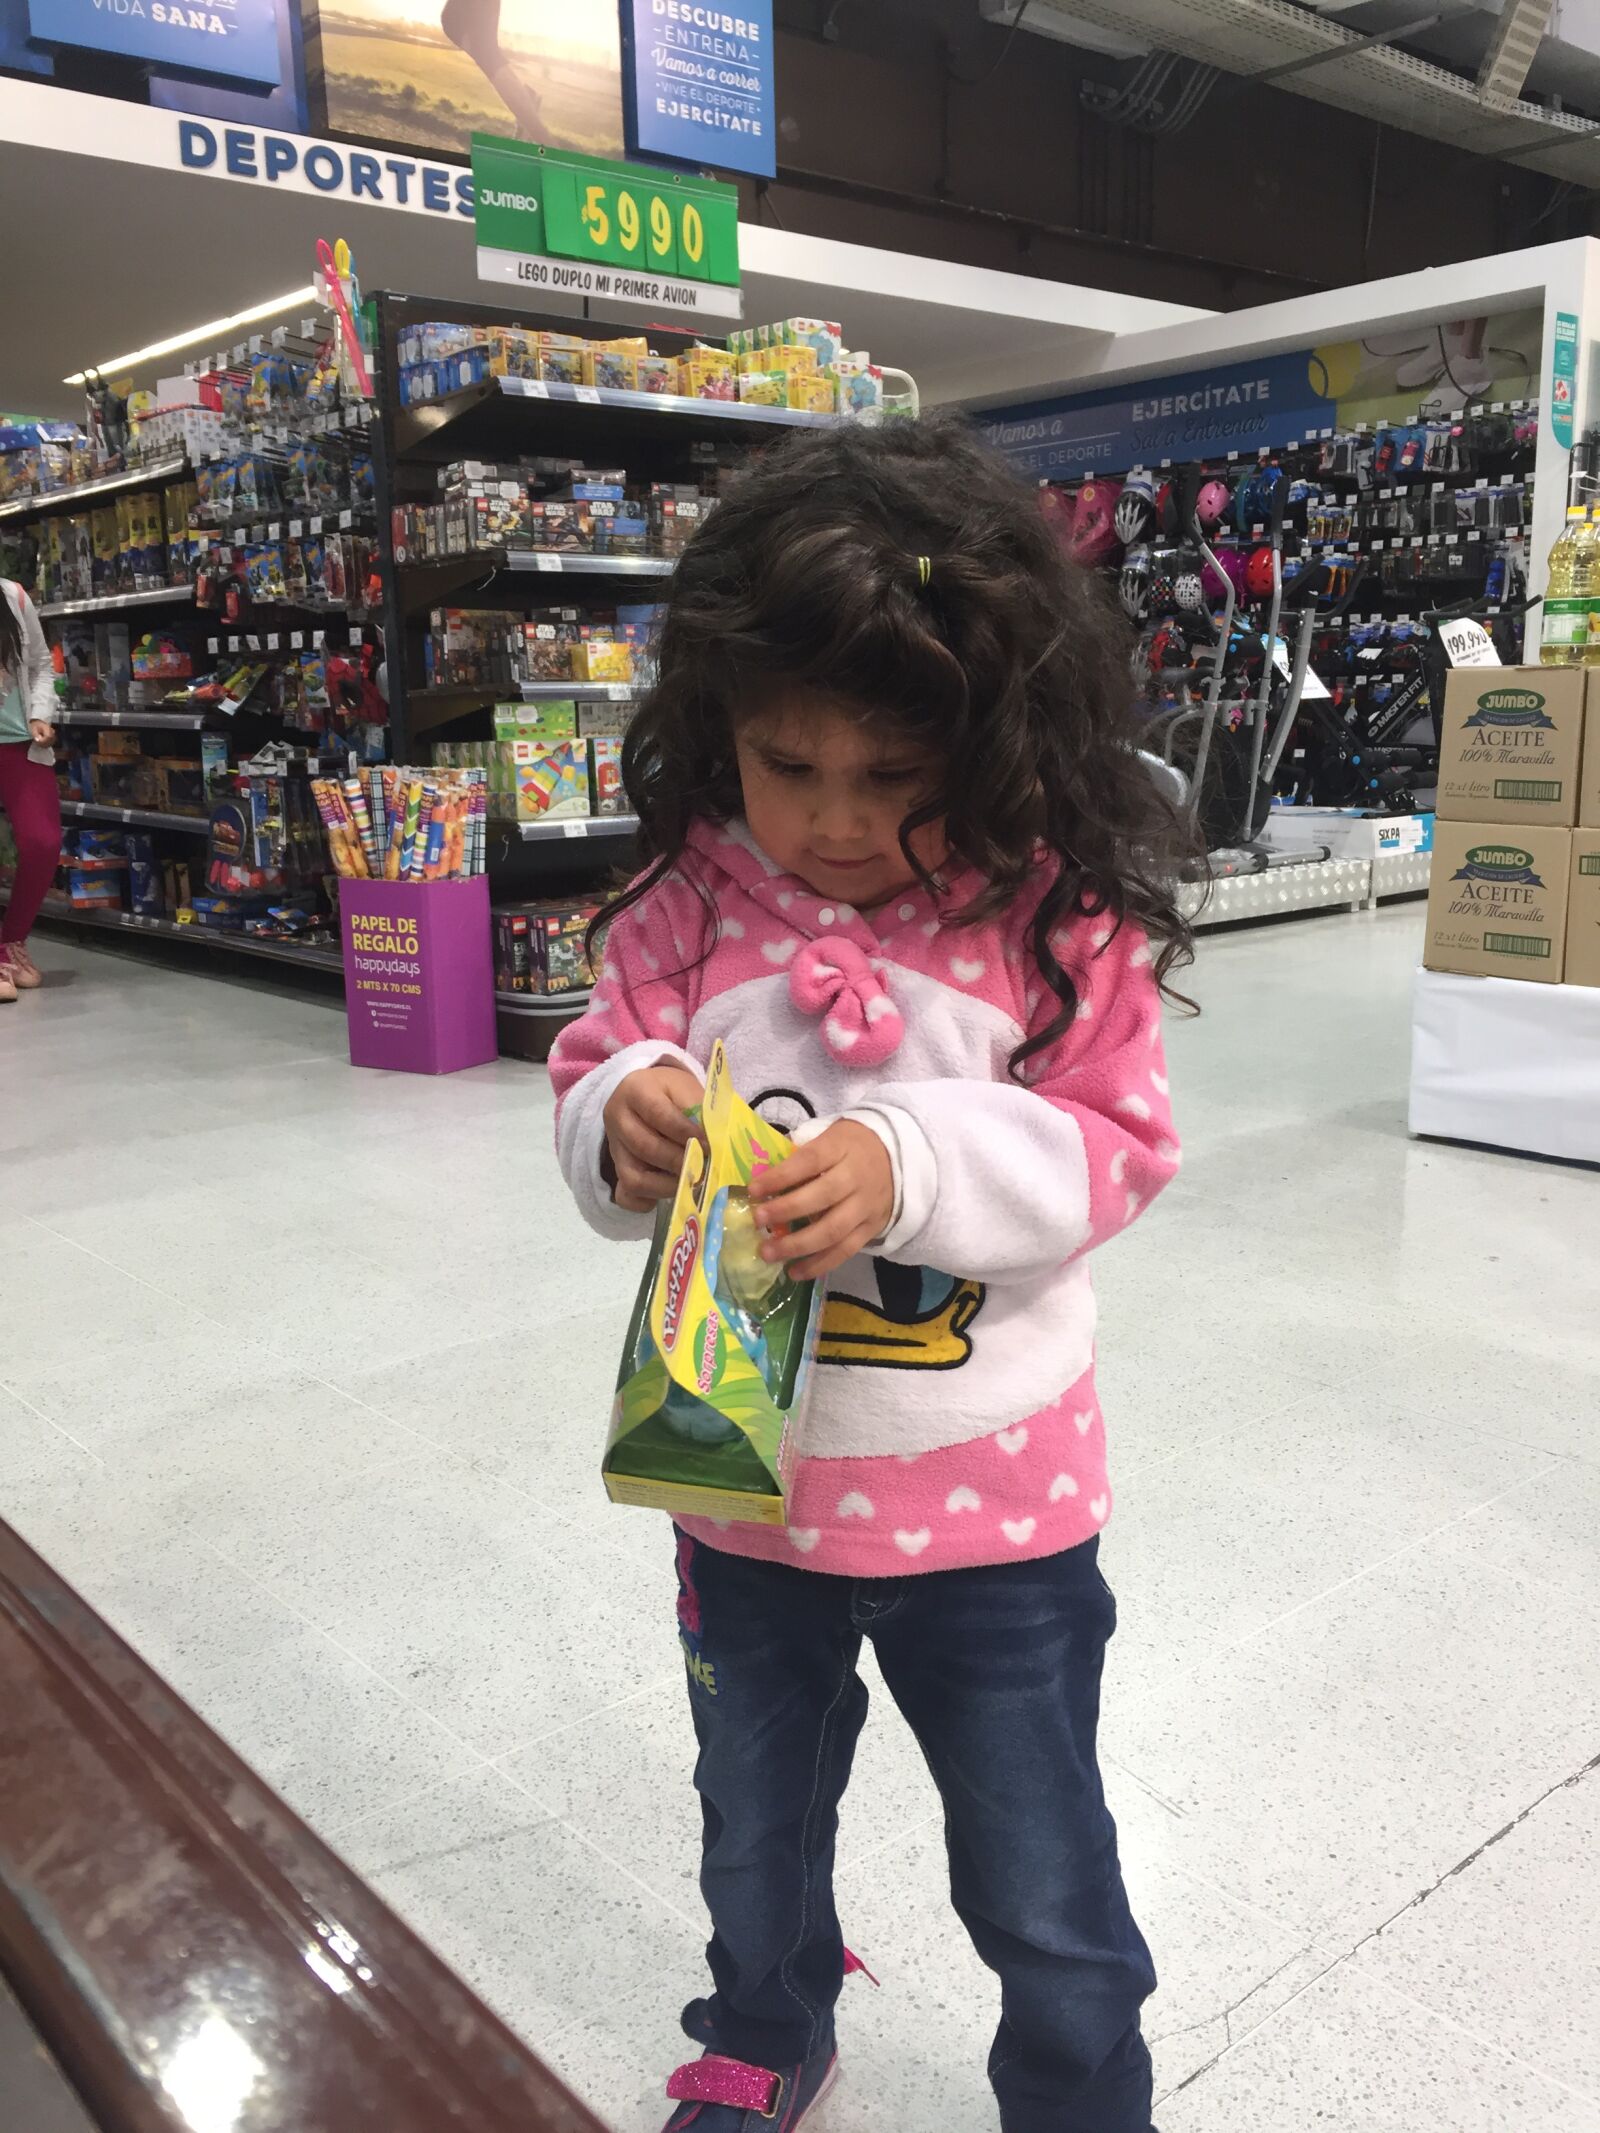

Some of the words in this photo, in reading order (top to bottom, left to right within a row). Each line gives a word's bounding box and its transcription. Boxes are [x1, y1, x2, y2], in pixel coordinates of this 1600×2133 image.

[151, 2, 227, 35] SANA
[652, 0, 760, 42] DESCUBRE
[664, 24, 750, 62] ENTRENA
[650, 47, 705, 77] Vamos
[706, 67, 718, 81] a
[719, 70, 762, 92] correr
[660, 80, 688, 98] VIVE
[690, 88, 703, 102] EL
[705, 91, 756, 114] DEPORTE
[656, 97, 762, 136] EJERCÍTATE
[178, 119, 476, 218] DEPORTES
[480, 188, 538, 212] JUMBO
[517, 261, 548, 282] LEGO
[552, 267, 592, 290] DUPLO
[595, 272, 610, 293] MI
[614, 278, 659, 300] PRIMER
[662, 285, 697, 306] AVION
[1132, 379, 1270, 422] EJERCÍTATE
[986, 420, 1046, 446] Vamos
[1050, 419, 1064, 435] a
[1048, 442, 1112, 465] DEPORTE
[1486, 694, 1539, 709] JUMBO
[1471, 728, 1545, 747] ACEITE
[1459, 749, 1492, 763] 100%
[1493, 749, 1555, 765] Maravilla
[1379, 828, 1390, 841] SIX
[1473, 850, 1527, 866] JUMBO
[1460, 882, 1534, 905] ACEITE
[1448, 901, 1482, 917] 100%
[1483, 902, 1545, 923] Maravilla
[351, 914, 396, 933] PAPEL
[397, 917, 418, 934] DE
[352, 932, 419, 955] REGALO
[354, 955, 421, 978] happydays
[356, 979, 363, 989] 2
[363, 980, 382, 991] MTS
[382, 982, 389, 992] X
[390, 982, 400, 993] 70
[401, 983, 422, 995] CMS
[697, 1308, 720, 1396] Sorpresas
